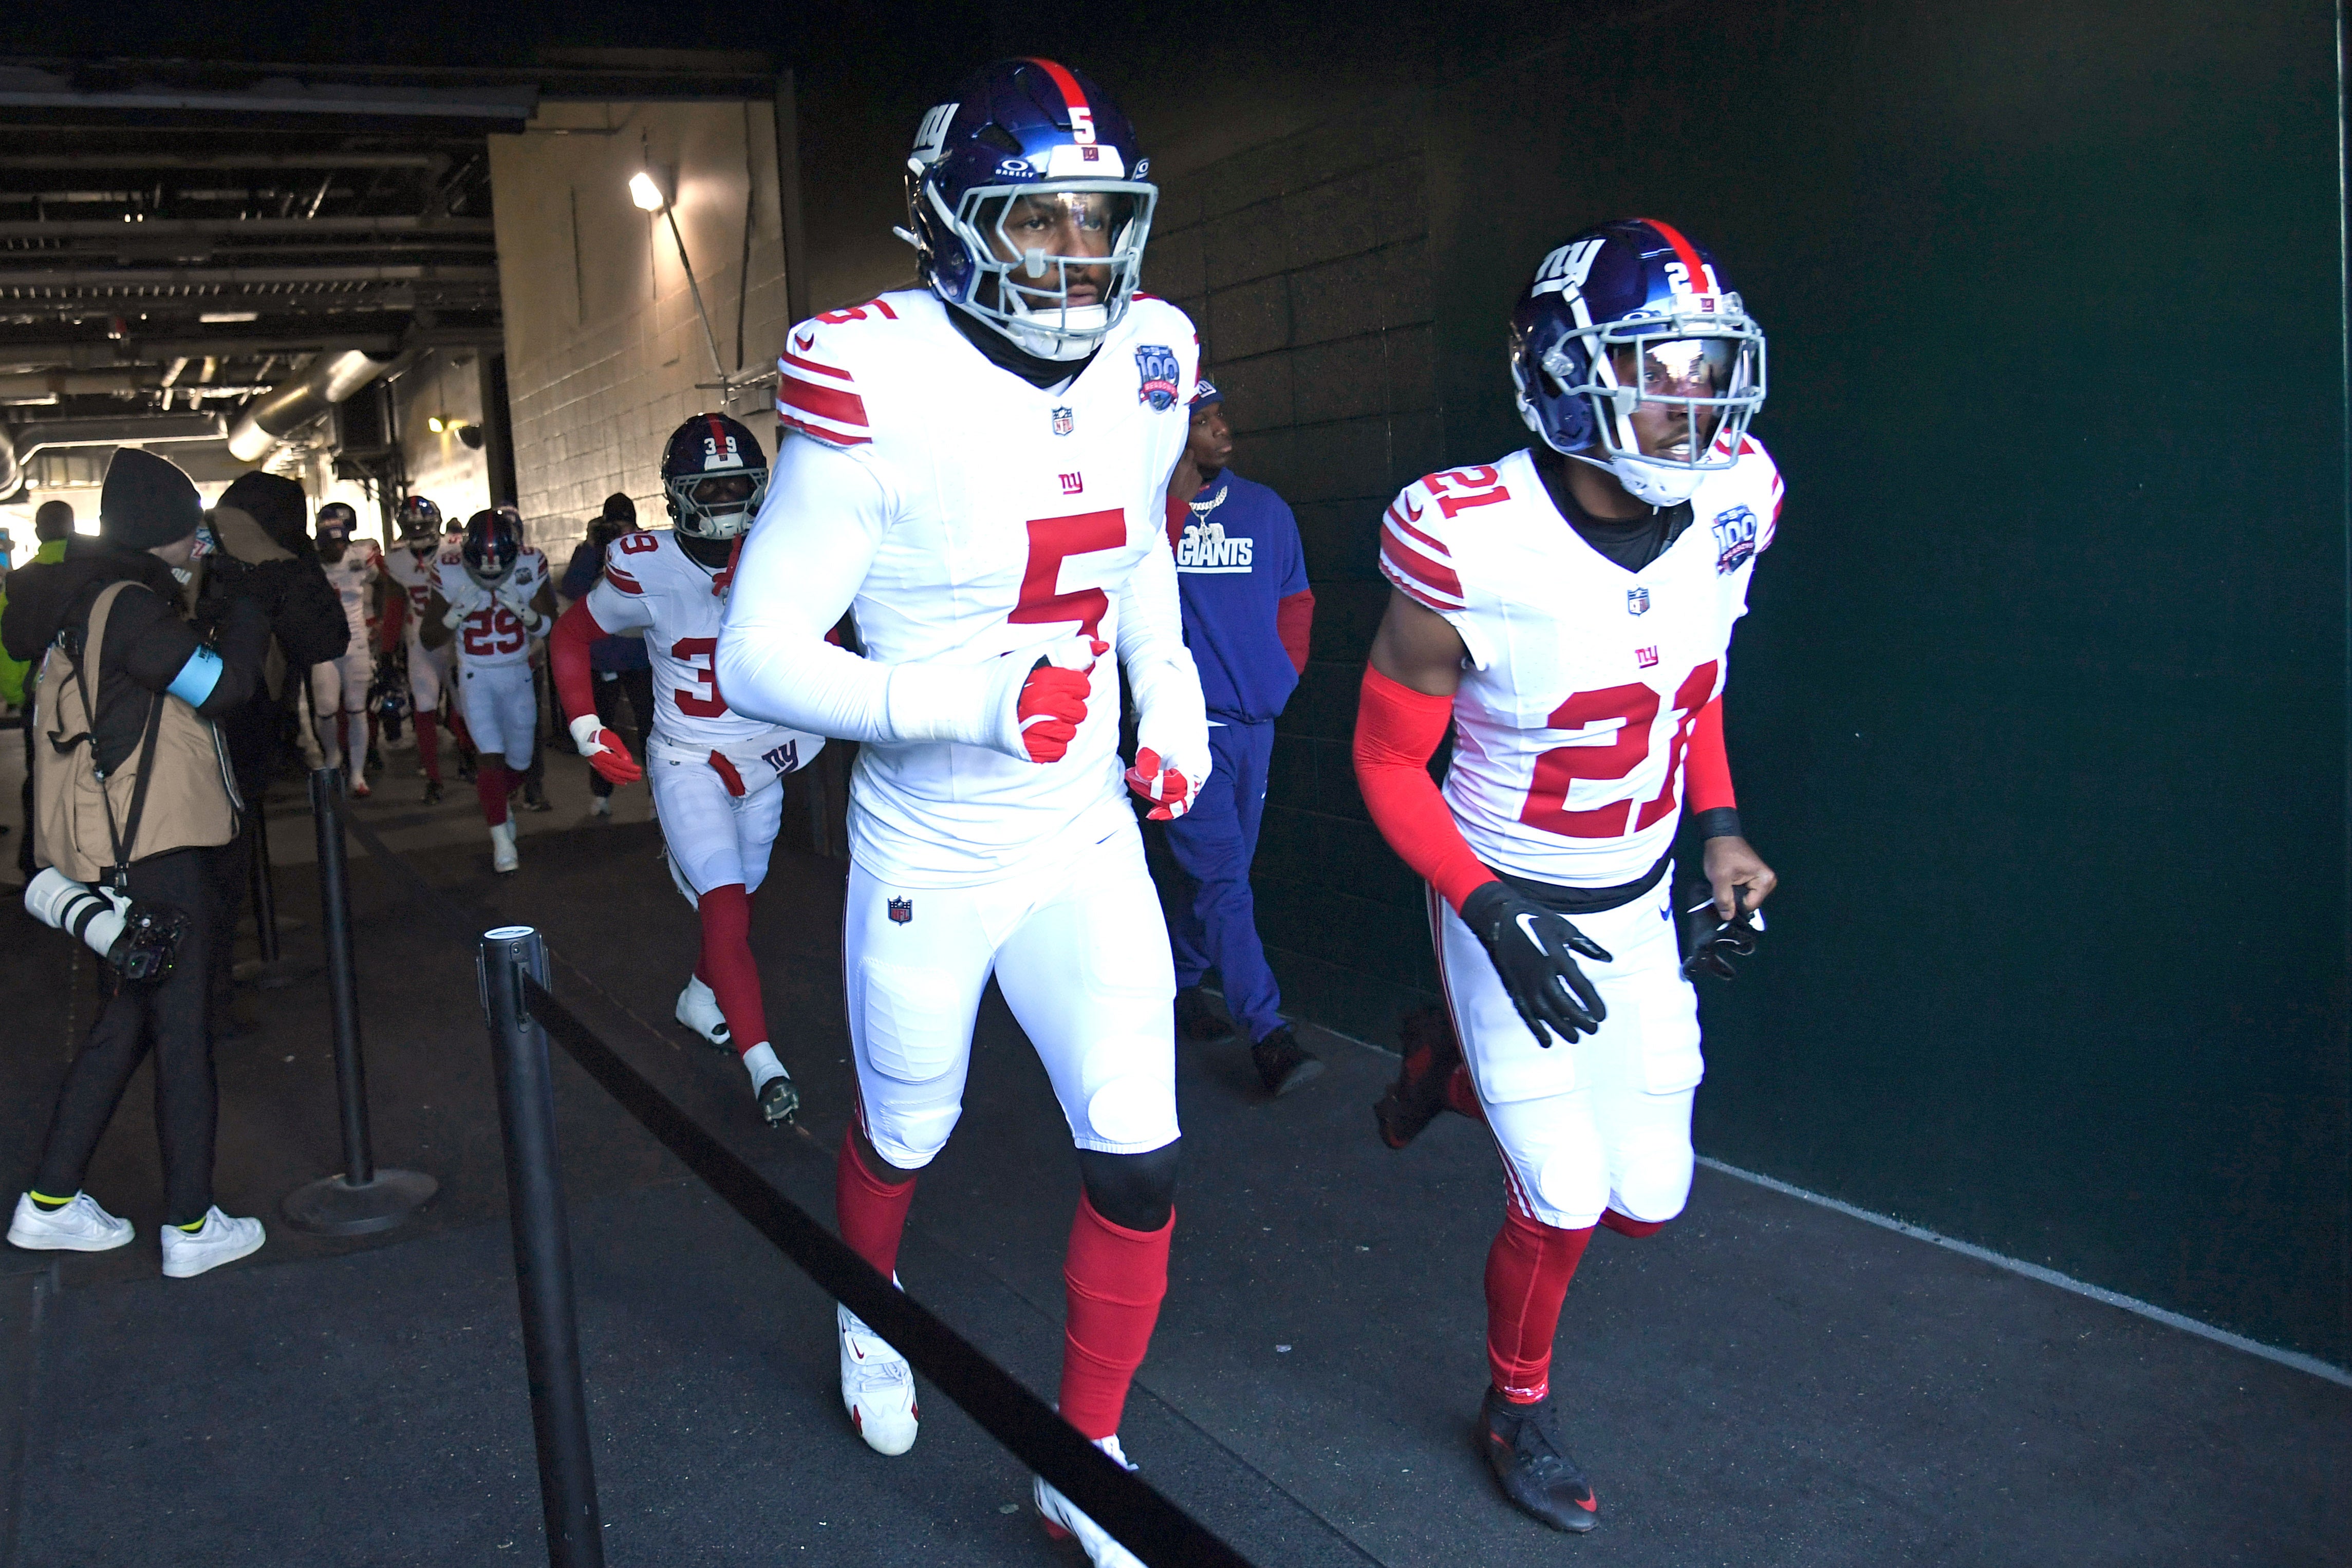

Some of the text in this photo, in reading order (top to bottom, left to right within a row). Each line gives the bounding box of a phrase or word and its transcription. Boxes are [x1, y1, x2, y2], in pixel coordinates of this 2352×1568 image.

[1068, 107, 1096, 144] 5
[1664, 262, 1721, 295] 21
[1136, 354, 1179, 386] 100
[704, 436, 737, 455] 39
[1420, 465, 1511, 519] 21
[619, 532, 659, 555] 9
[1177, 538, 1253, 566] GIANTS
[1713, 514, 1756, 553] 100
[1001, 508, 1126, 676] 5
[463, 607, 525, 656] 29
[672, 637, 730, 718] 3
[1519, 659, 1718, 838] 21
